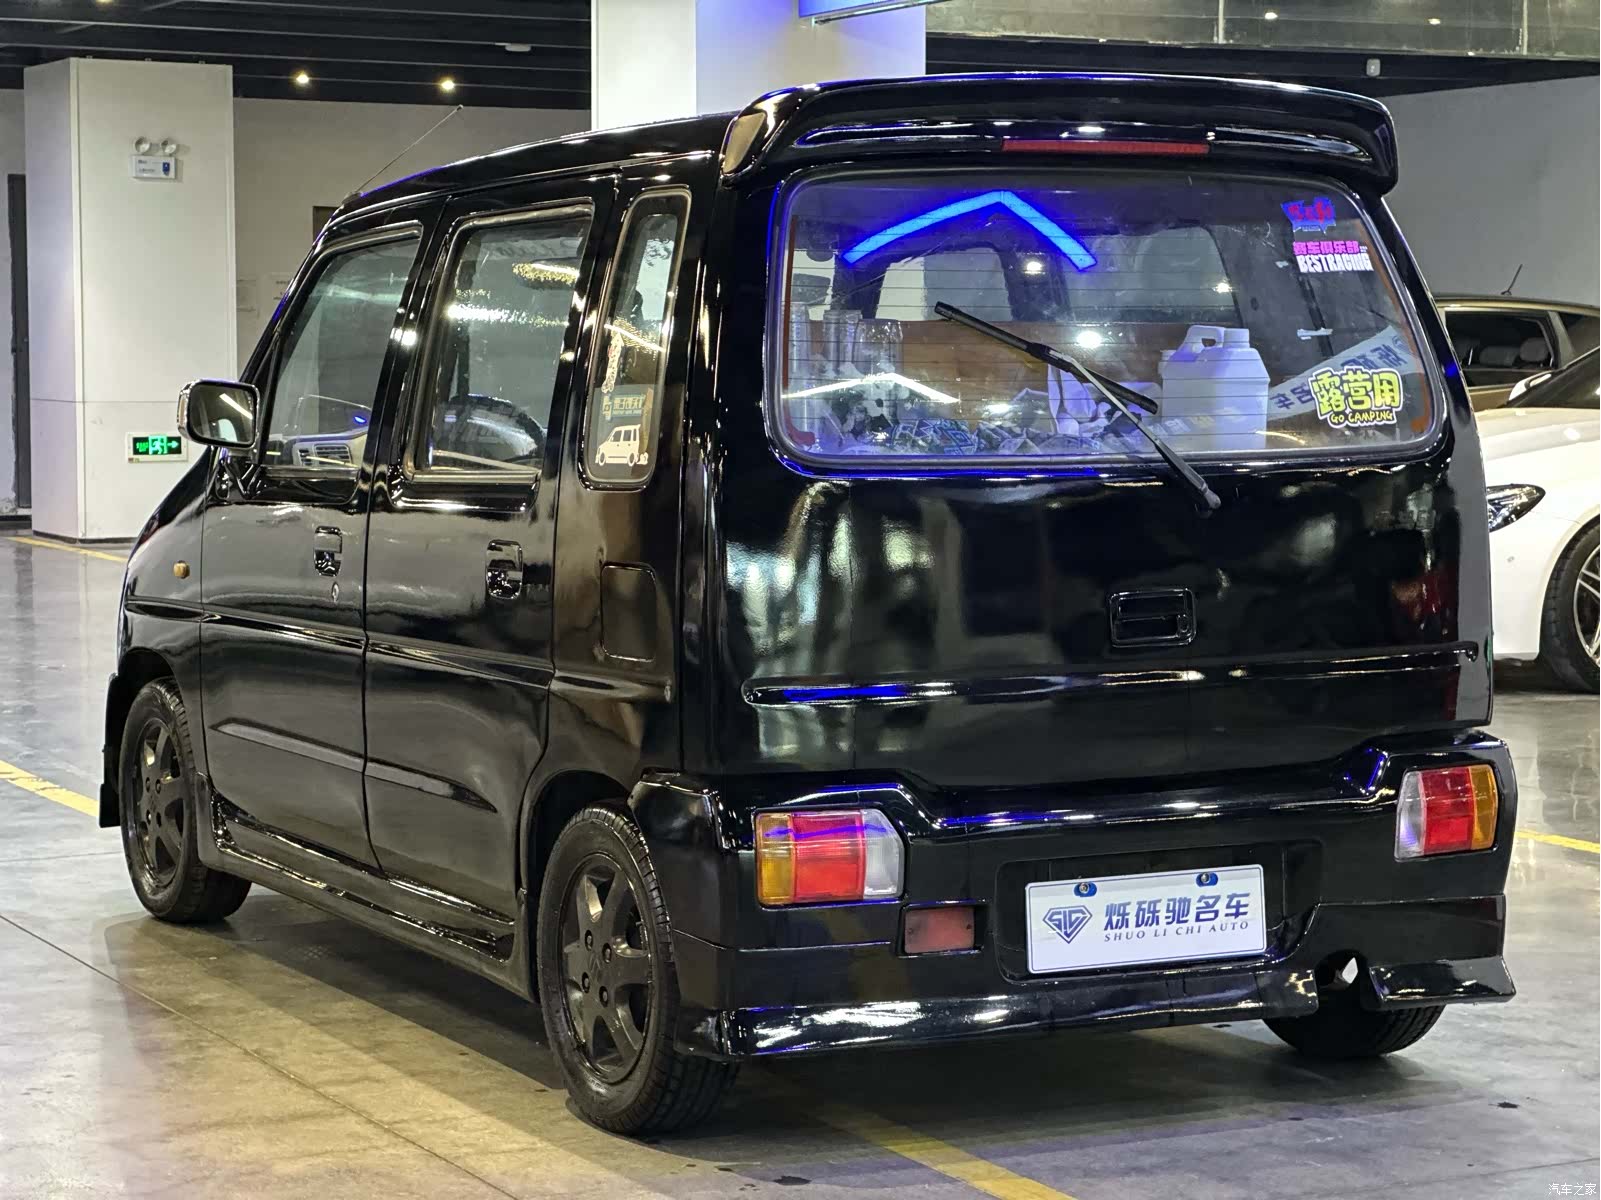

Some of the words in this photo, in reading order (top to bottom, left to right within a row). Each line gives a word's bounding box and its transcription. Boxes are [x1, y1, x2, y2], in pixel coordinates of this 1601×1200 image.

[1296, 252, 1374, 273] BESTRACING
[1312, 370, 1400, 415] 露营用
[1330, 413, 1345, 423] GO
[1348, 410, 1393, 423] CAMPING
[1103, 892, 1251, 931] 烁砾驰名车
[1104, 930, 1146, 942] SHUO
[1153, 928, 1168, 938] LI
[1175, 924, 1201, 936] CHI
[1208, 920, 1249, 933] AUTO
